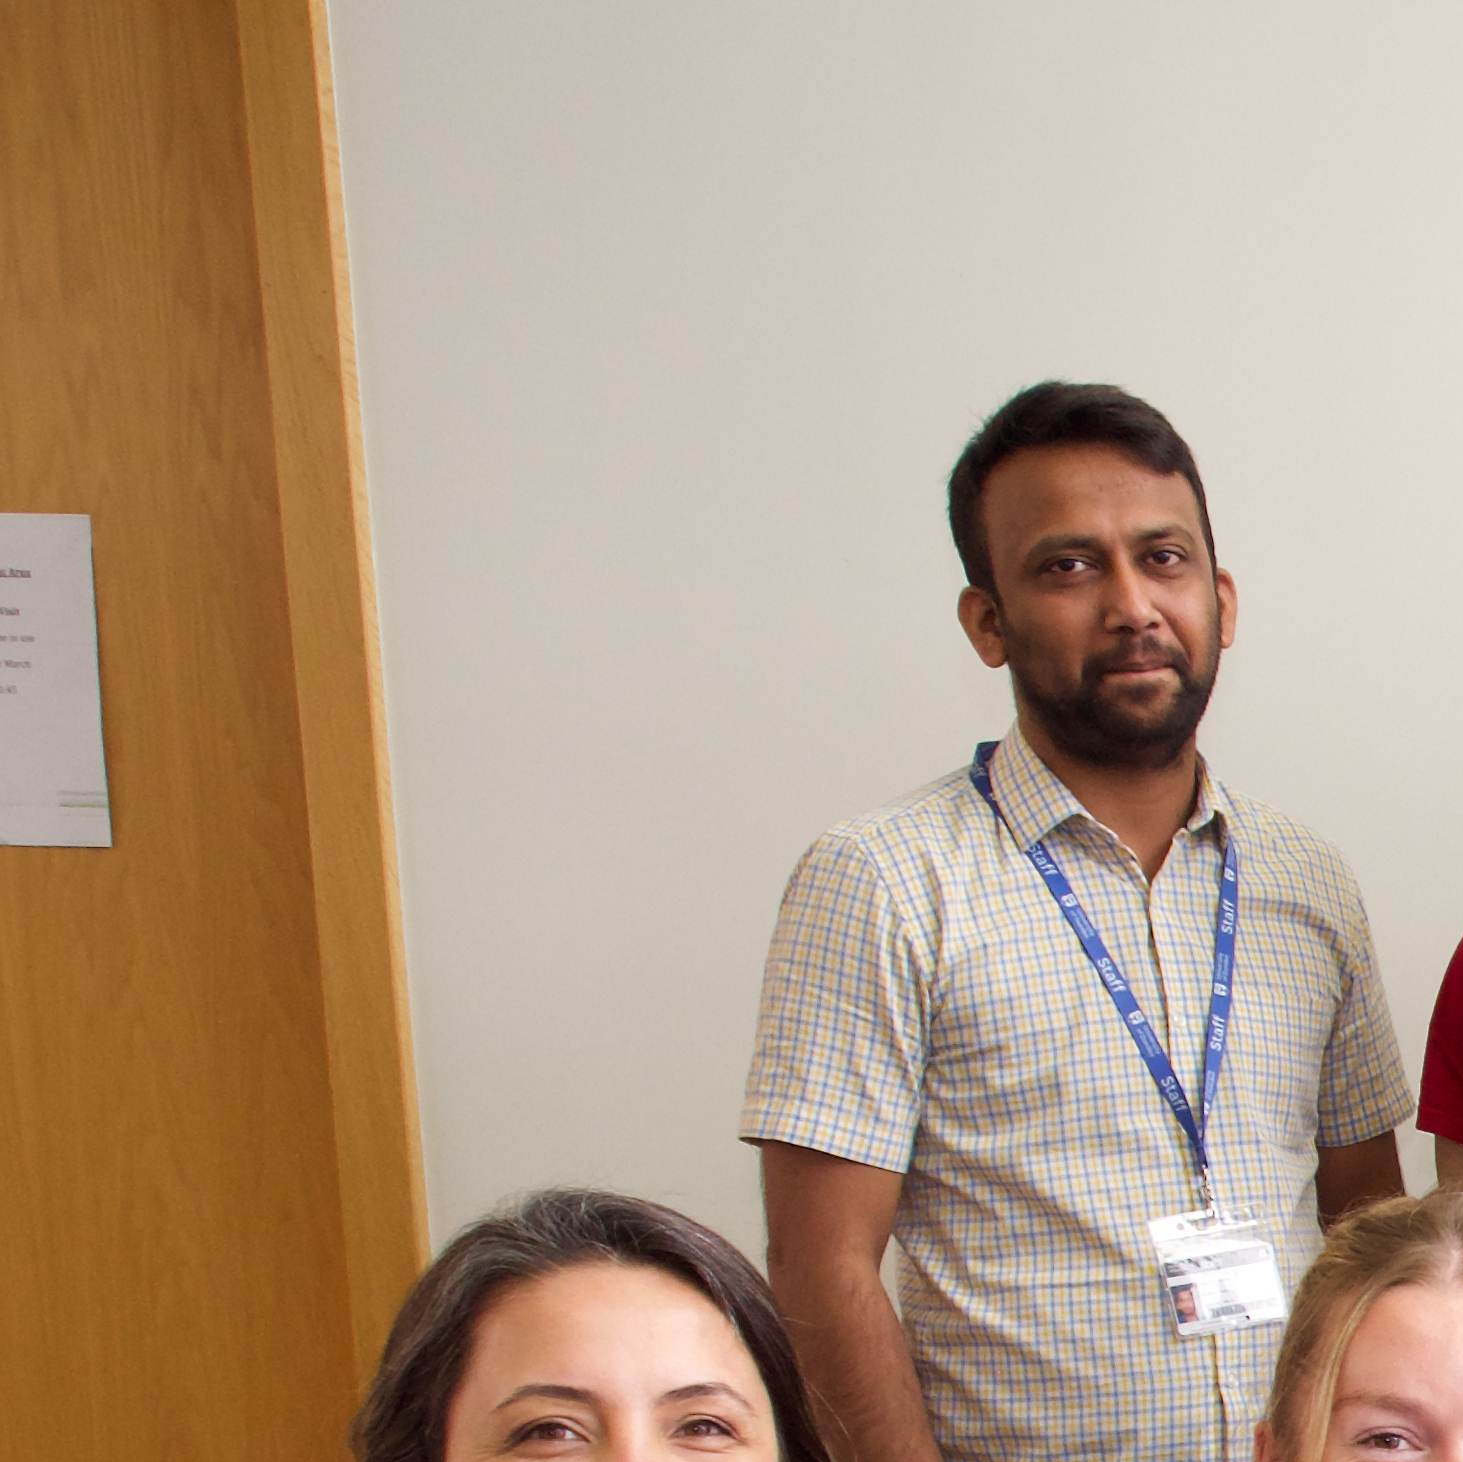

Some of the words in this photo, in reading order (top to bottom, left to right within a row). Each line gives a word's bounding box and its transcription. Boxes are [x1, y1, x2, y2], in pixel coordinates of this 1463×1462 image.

[1030, 842, 1058, 876] Staff
[1221, 898, 1235, 935] Staff
[1097, 957, 1126, 992] Staff
[1210, 1013, 1226, 1051] Staff
[1160, 1076, 1188, 1112] Staff
